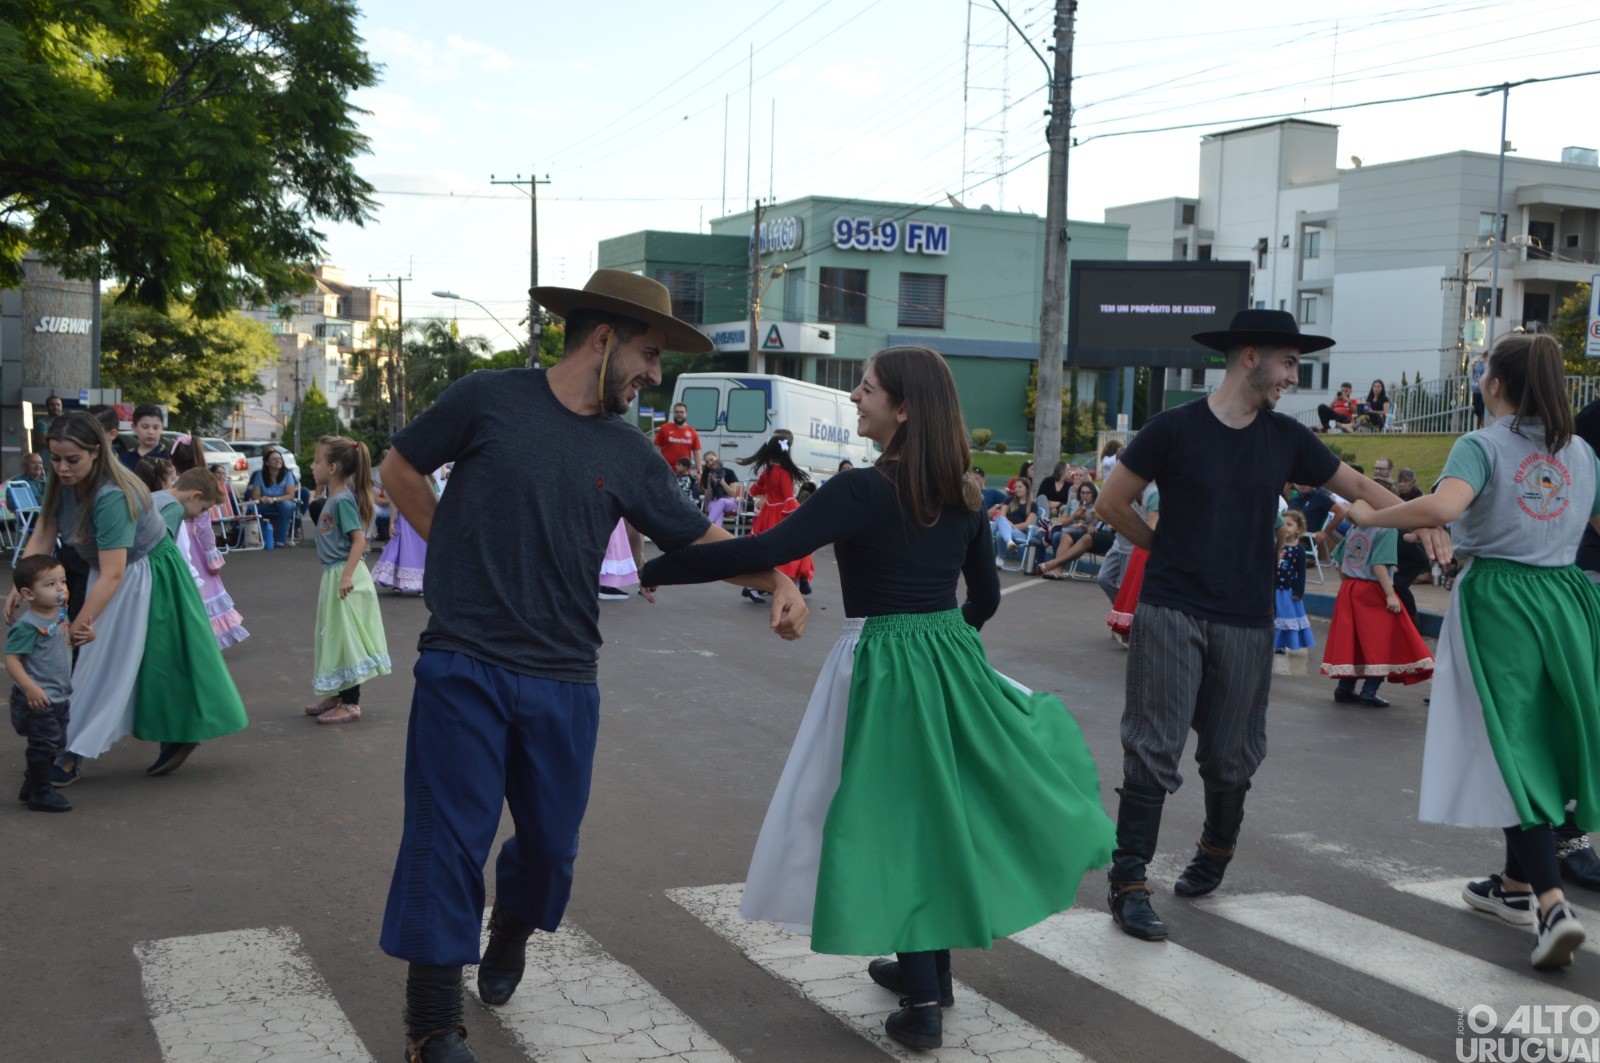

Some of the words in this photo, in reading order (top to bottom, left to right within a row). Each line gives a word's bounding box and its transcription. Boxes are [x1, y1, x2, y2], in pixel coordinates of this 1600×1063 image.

[769, 217, 796, 251] 1160
[834, 216, 899, 251] 95.9
[906, 221, 950, 254] FM
[1100, 304, 1115, 313] TEM
[1117, 304, 1129, 313] UM
[1130, 303, 1170, 314] PROPÓSITO
[1172, 305, 1182, 314] DE
[1184, 305, 1216, 314] EXISTIR?
[34, 316, 93, 335] SUBWAY
[809, 422, 850, 445] LEOMAR
